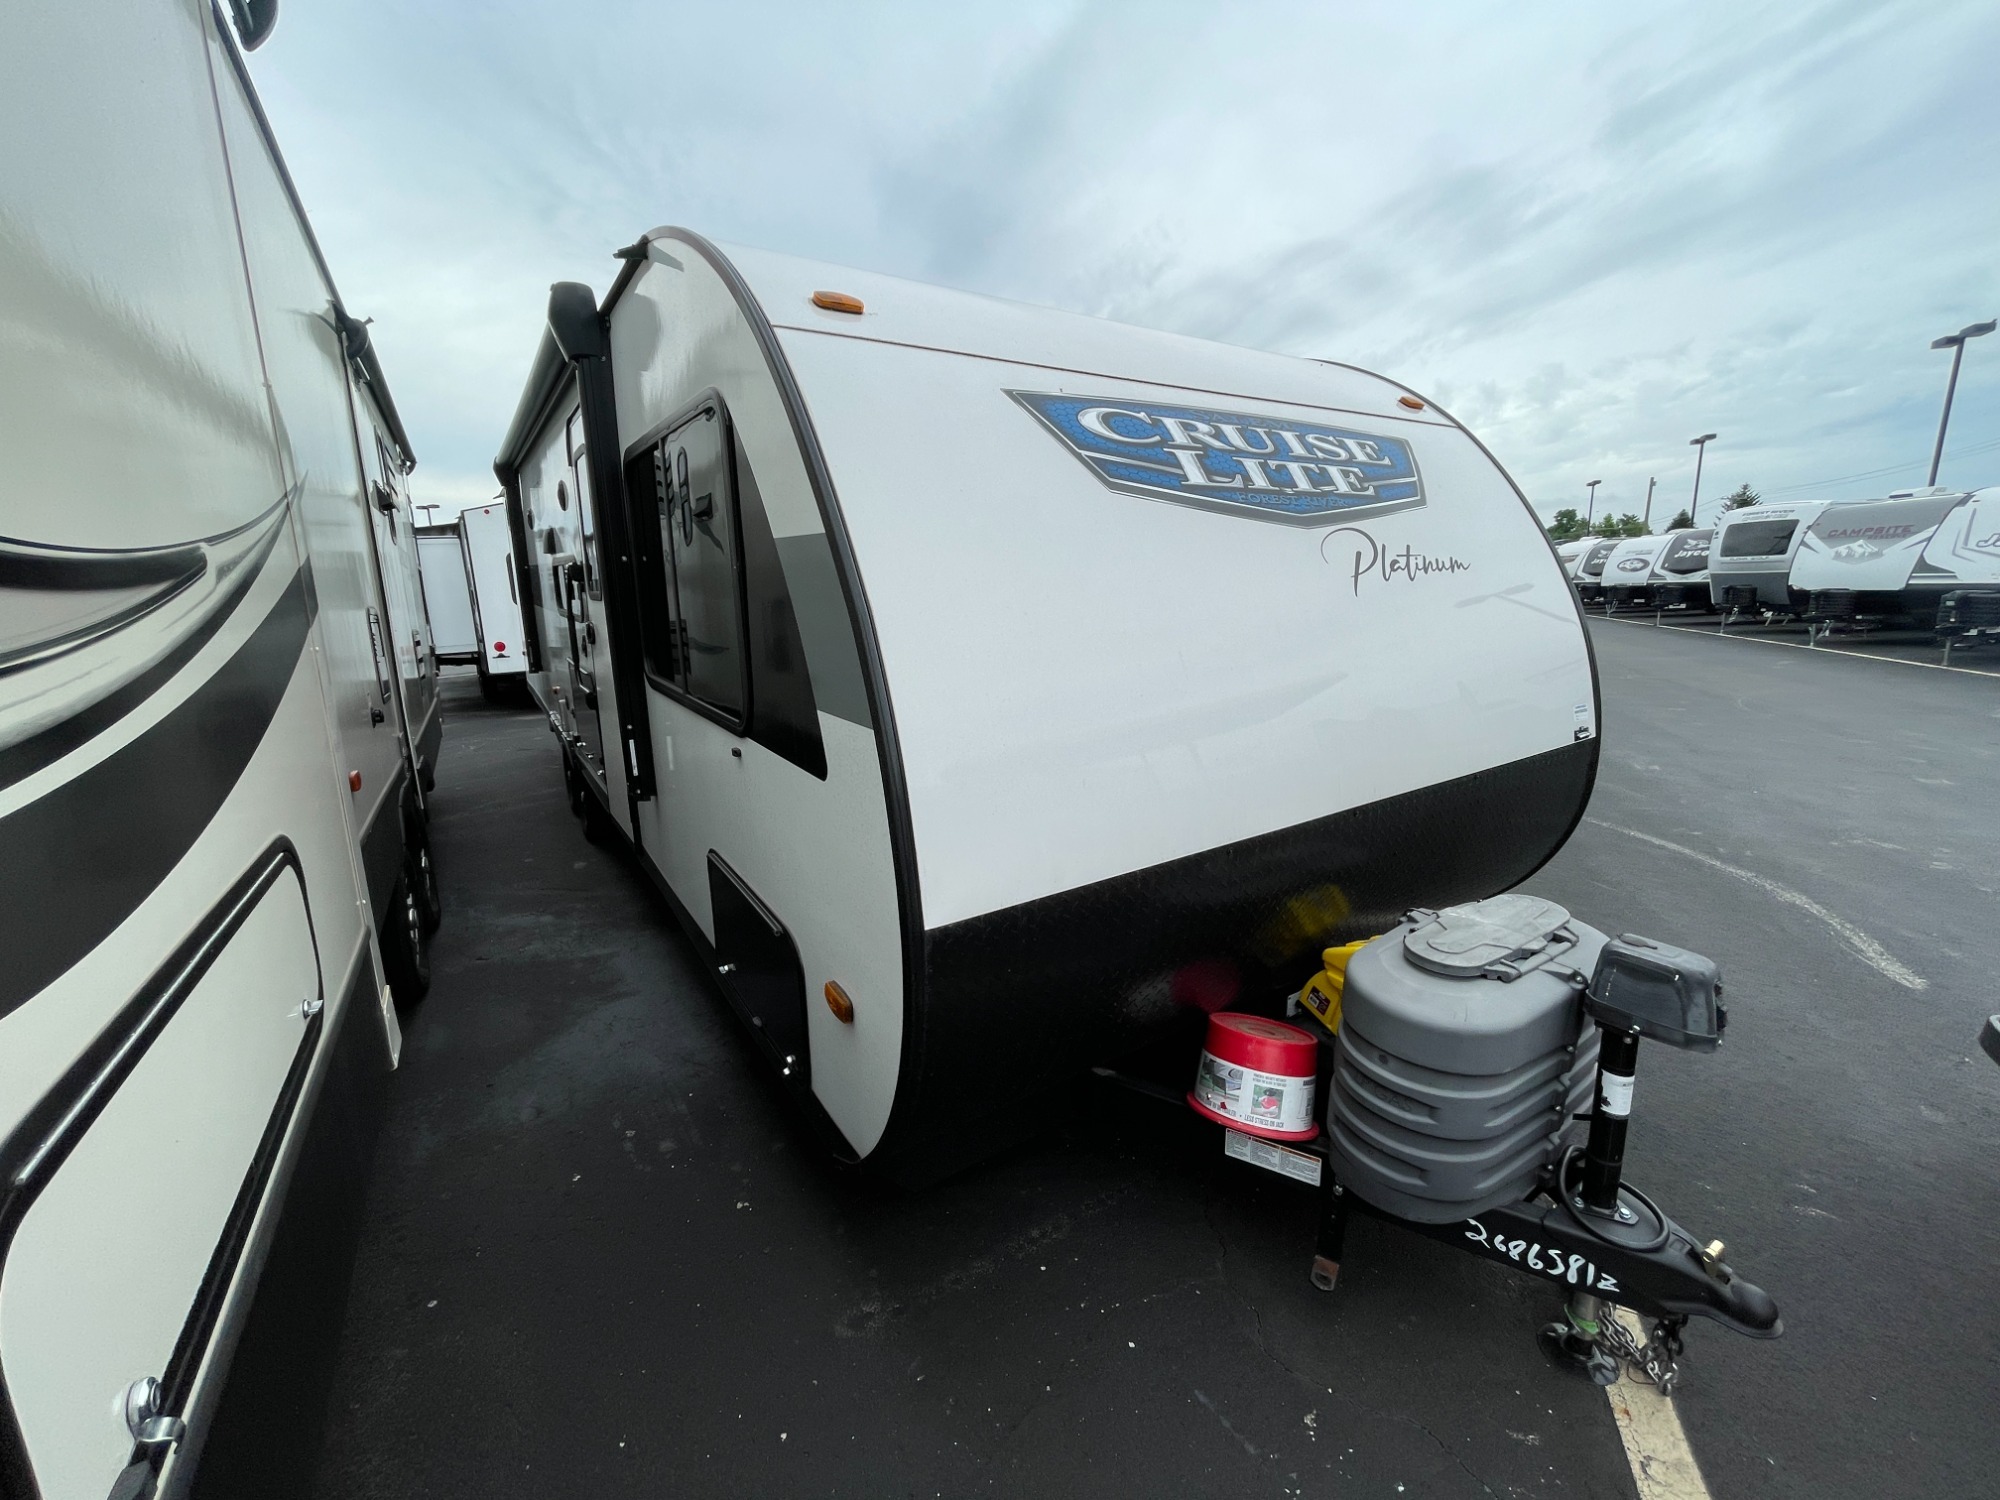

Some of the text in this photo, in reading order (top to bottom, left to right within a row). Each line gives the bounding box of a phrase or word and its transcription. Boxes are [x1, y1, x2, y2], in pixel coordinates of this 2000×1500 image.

[1077, 407, 1392, 467] CRUISE
[1165, 448, 1376, 496] LITE
[1236, 491, 1349, 507] FOREST RIVER
[1827, 524, 1916, 539] CAMPSITE
[1320, 527, 1471, 597] Platinum
[1673, 550, 1710, 558] Jayco
